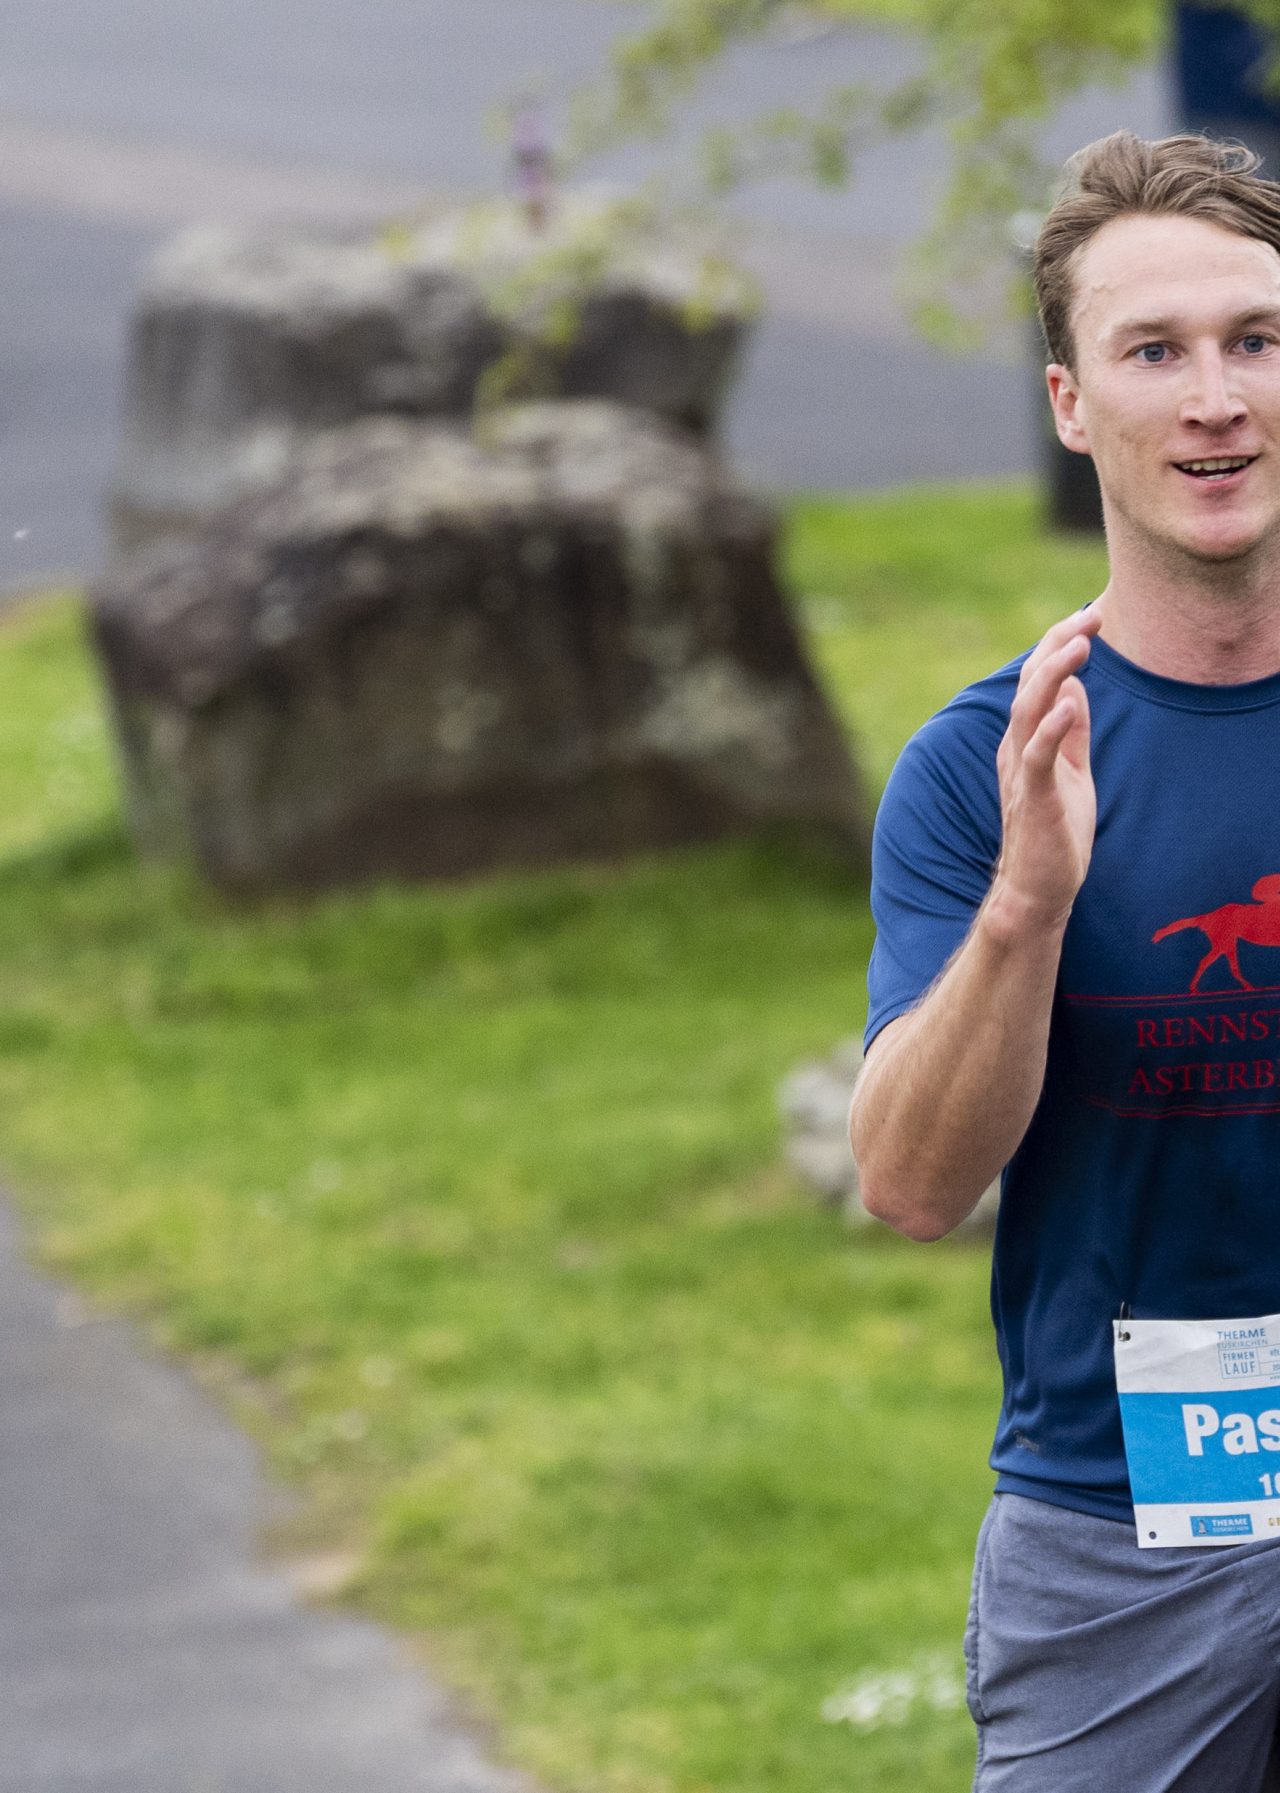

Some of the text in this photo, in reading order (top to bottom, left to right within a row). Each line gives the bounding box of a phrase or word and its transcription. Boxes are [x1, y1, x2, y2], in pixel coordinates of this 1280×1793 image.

[1217, 1327, 1266, 1340] THERME
[1223, 1351, 1255, 1361] FIRMEN
[1224, 1361, 1256, 1375] LAUF
[1211, 1518, 1249, 1527] THERME
